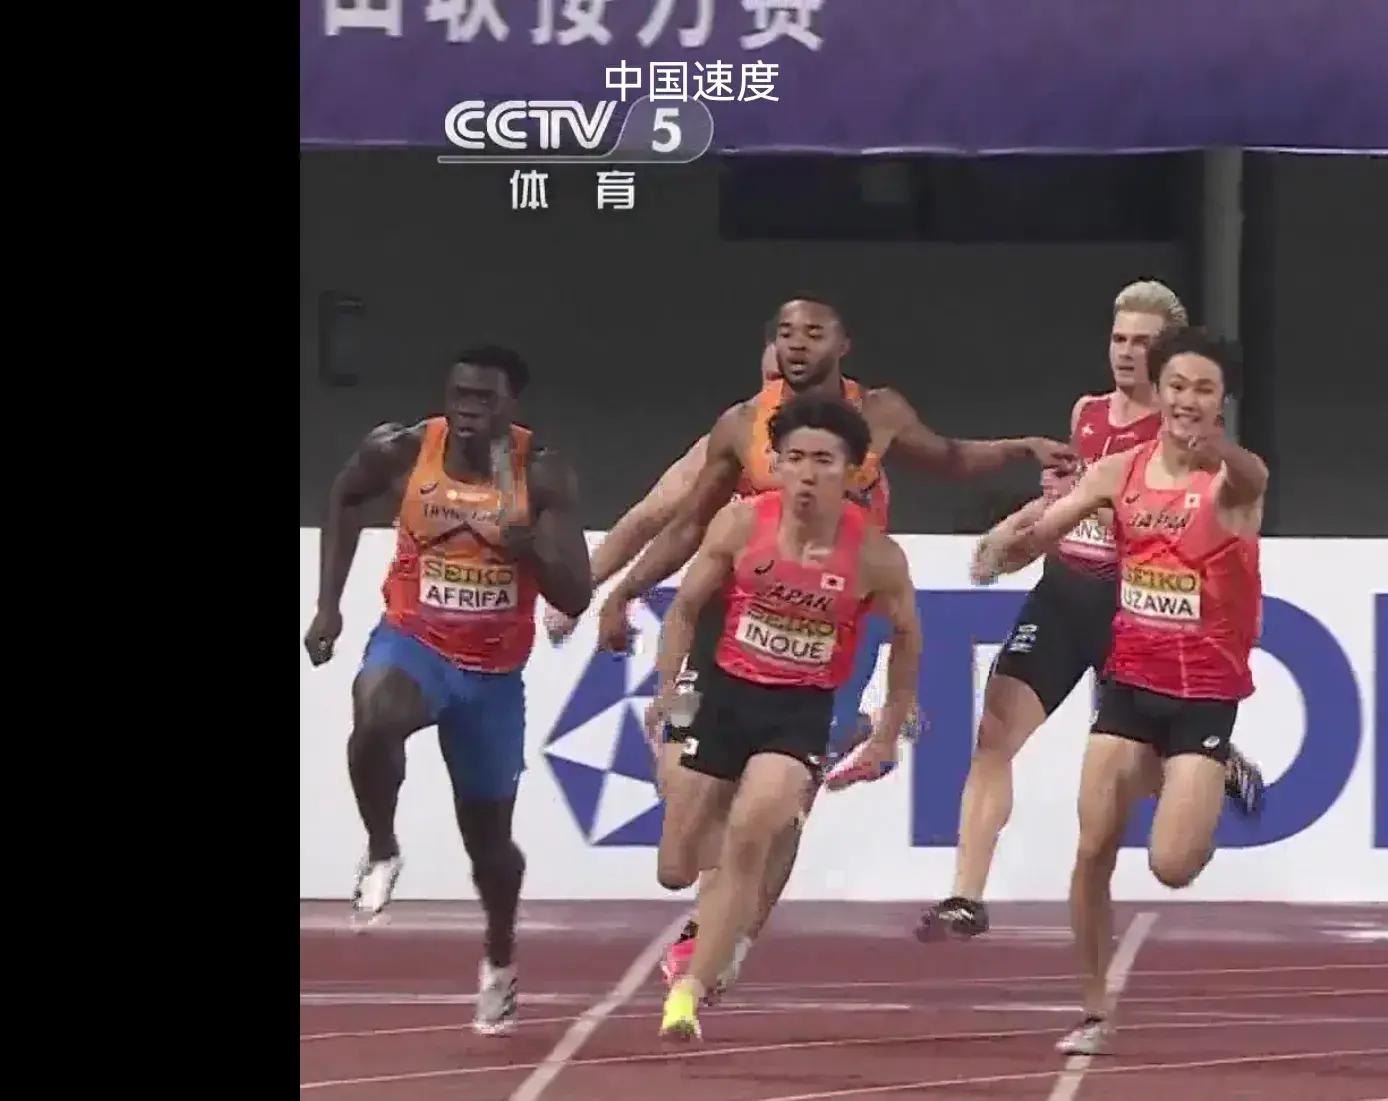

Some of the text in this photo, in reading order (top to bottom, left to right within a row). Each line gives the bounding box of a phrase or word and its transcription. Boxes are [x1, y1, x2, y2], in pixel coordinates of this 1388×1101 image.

[424, 560, 513, 586] SEIKO
[426, 584, 512, 609] AFRIFA
[1123, 589, 1194, 616] UZAWA
[748, 602, 835, 636] SEIKO
[745, 622, 826, 660] INOUE
